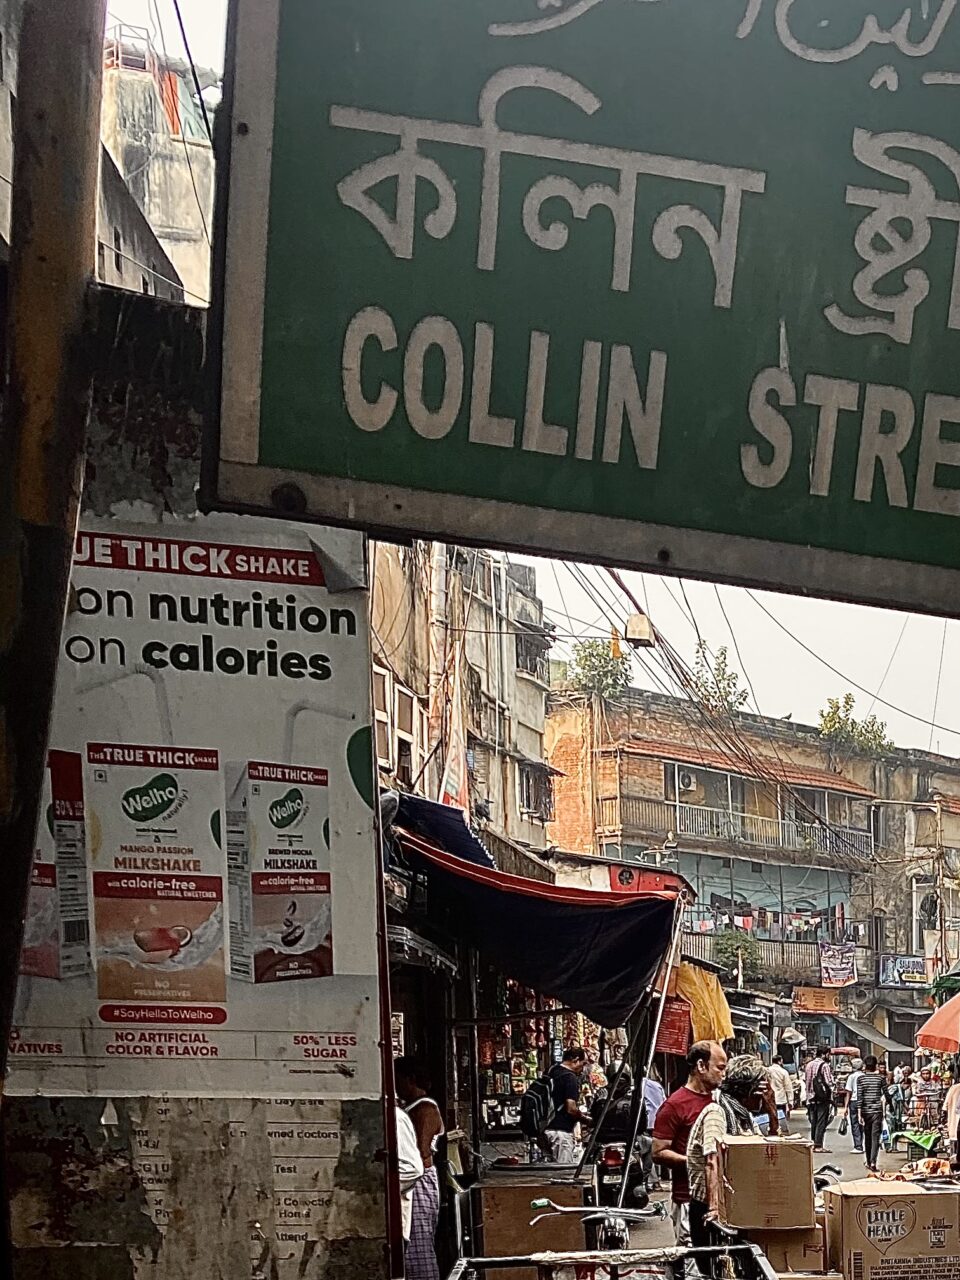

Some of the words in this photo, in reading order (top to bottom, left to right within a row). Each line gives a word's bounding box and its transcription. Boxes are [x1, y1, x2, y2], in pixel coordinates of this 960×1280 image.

[329, 65, 766, 308] কলিন
[341, 306, 667, 470] COLLIN
[121, 540, 232, 574] THICK
[235, 554, 310, 577] SHAKE
[76, 587, 133, 618] on
[149, 591, 357, 636] nutrition
[65, 635, 126, 666] on
[142, 635, 332, 681] calories
[103, 748, 144, 763] TRUE
[147, 750, 195, 766] THICK
[257, 766, 282, 779] TRUE
[284, 768, 314, 782] THICK
[123, 784, 177, 815] Welho
[269, 799, 302, 824] Welho
[120, 844, 154, 854] MANGO
[156, 846, 194, 855] PASSION
[114, 856, 202, 872] MILKSHAKE
[264, 858, 318, 870] MILKSHAKE
[121, 876, 196, 891] calorie-free
[268, 875, 314, 886] calorie-free
[155, 980, 170, 989] NO
[113, 1008, 214, 1021] #SayHelloToWelho
[115, 1032, 136, 1044] NO
[138, 1032, 209, 1045] ARTIFICIAL
[327, 1036, 357, 1046] LESS
[105, 1044, 153, 1056] COLOR
[155, 1045, 165, 1056] &
[168, 1045, 219, 1057] FLAVOR
[303, 1048, 348, 1059] SUGAR
[275, 1164, 297, 1174] Test
[866, 1209, 906, 1225] LITTLE
[867, 1224, 907, 1238] HEARTS
